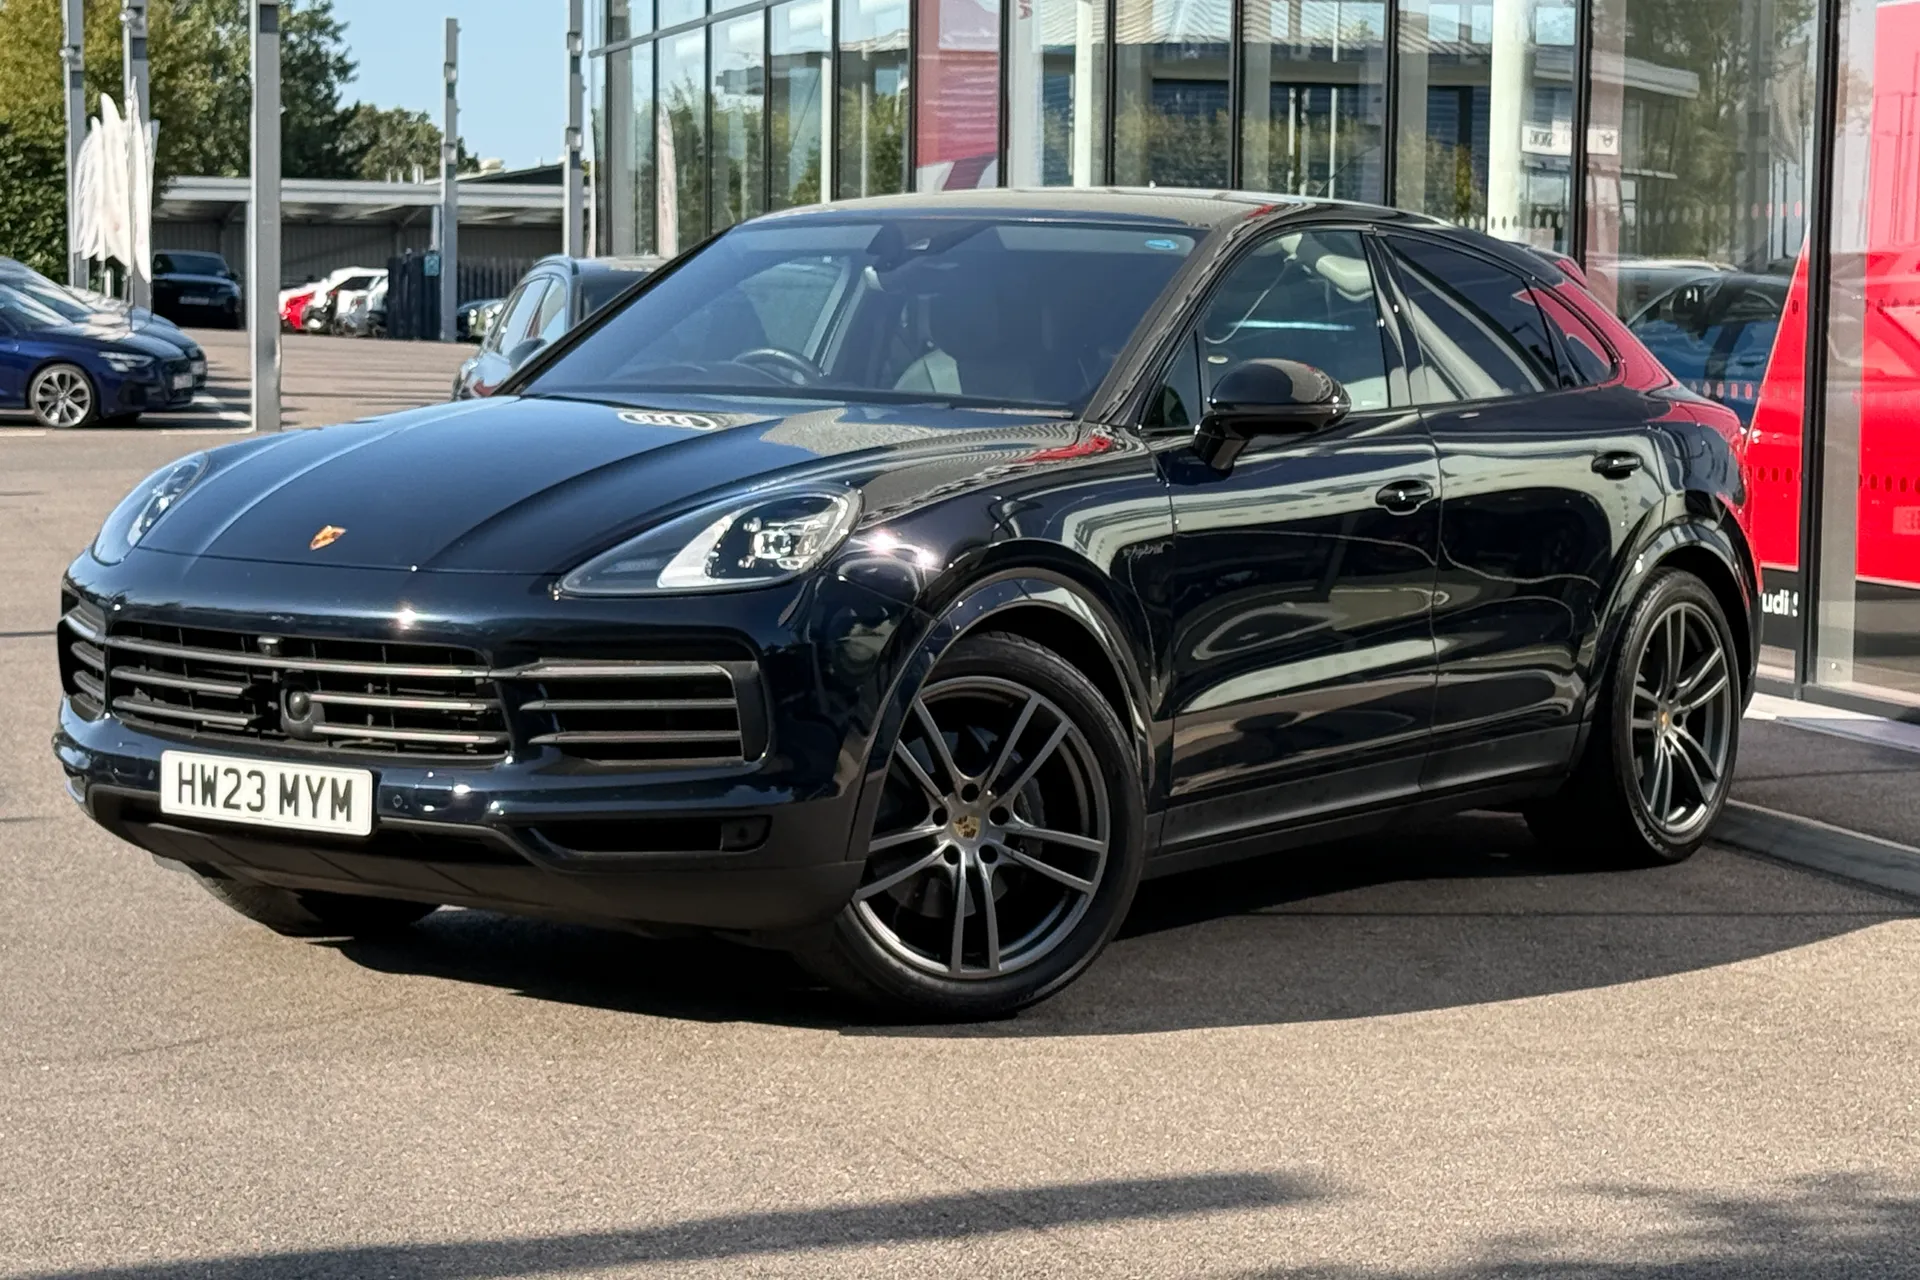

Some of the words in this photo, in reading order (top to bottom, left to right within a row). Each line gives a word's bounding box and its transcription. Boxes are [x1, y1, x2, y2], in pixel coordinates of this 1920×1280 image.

[1761, 588, 1789, 615] udi
[178, 762, 266, 812] HW23
[279, 772, 353, 822] MYM
